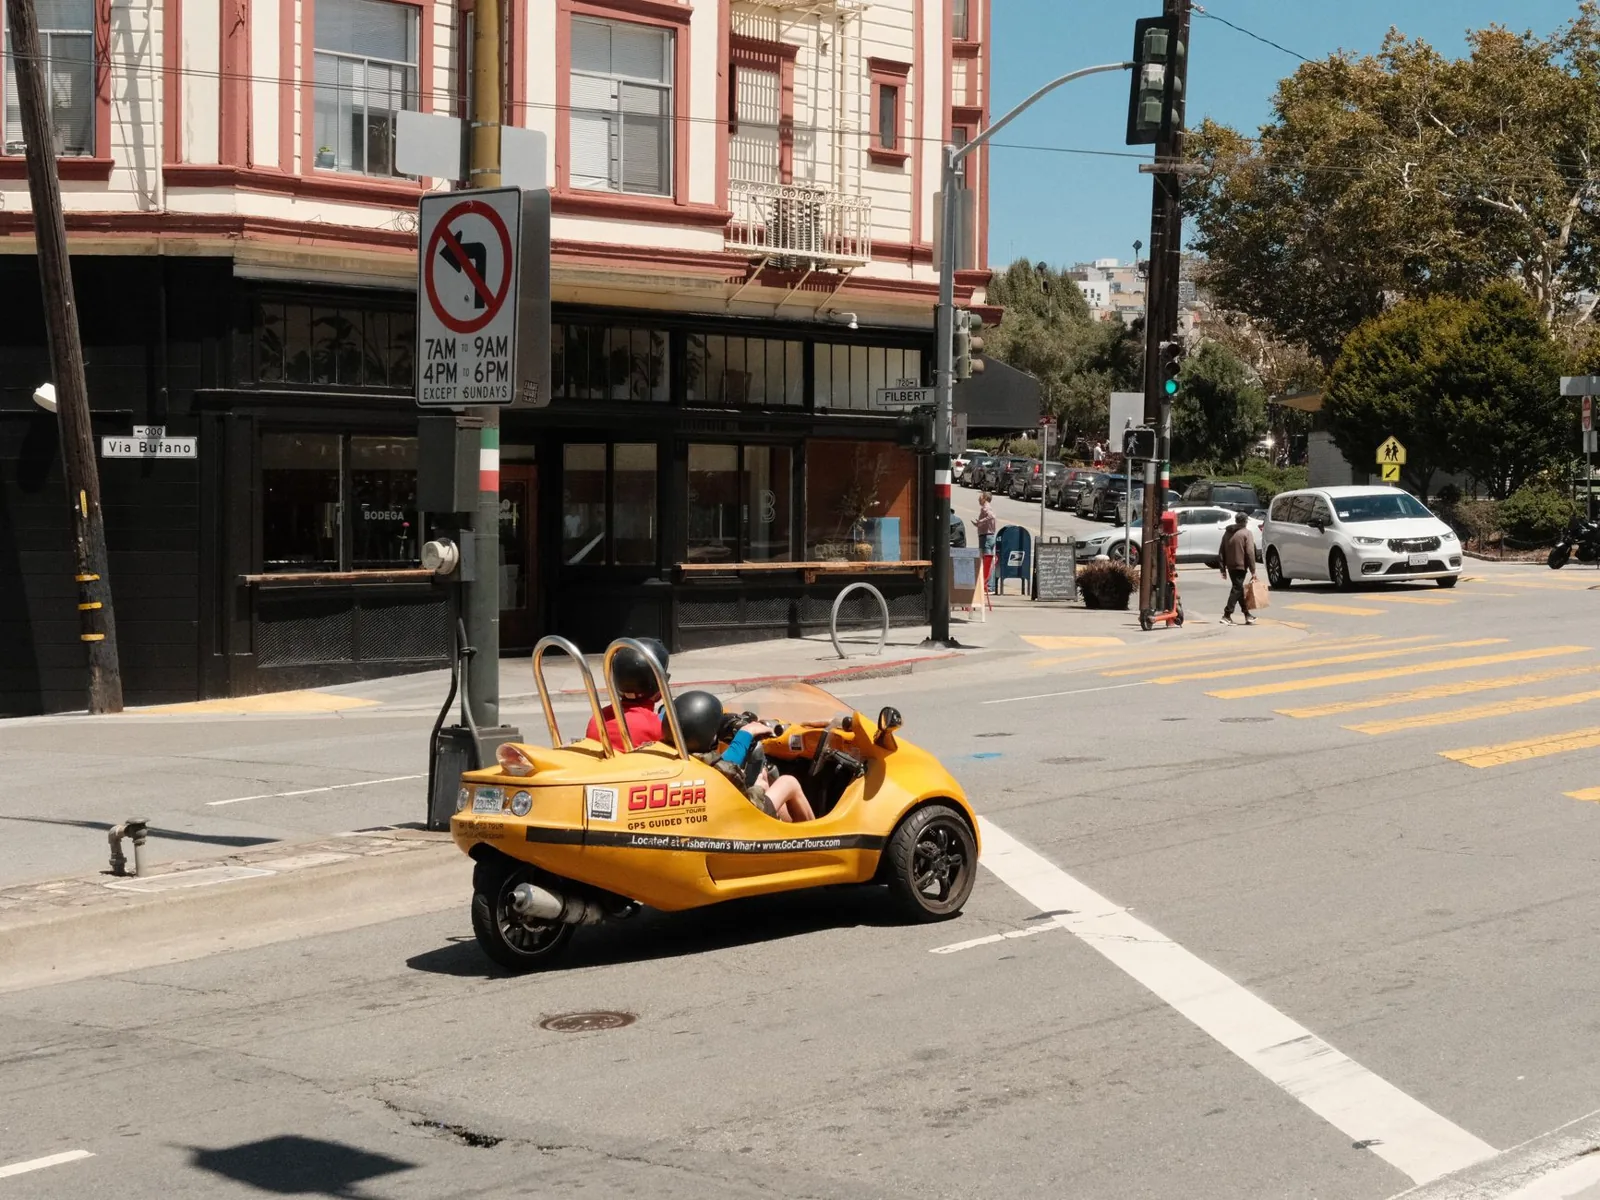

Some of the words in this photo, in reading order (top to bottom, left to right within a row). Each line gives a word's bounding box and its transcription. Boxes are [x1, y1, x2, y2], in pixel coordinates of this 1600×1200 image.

[424, 337, 456, 360] 7AM
[461, 343, 469, 352] TO
[474, 336, 508, 358] 9AM
[423, 362, 458, 384] 4PM
[462, 367, 470, 377] TO
[474, 361, 508, 383] 6PM
[423, 386, 457, 400] EXCEPT
[462, 385, 508, 399] SUNDAYS
[884, 390, 927, 402] FILBERT
[144, 427, 163, 436] 000
[108, 441, 131, 453] Via
[138, 441, 191, 453] Bufano
[363, 510, 405, 521] BODEGA
[627, 821, 646, 831] GPS
[648, 818, 683, 828] GUIDED
[686, 814, 708, 824] TOUR
[631, 834, 669, 846] Located
[733, 841, 756, 851] Wharf
[762, 839, 841, 850] www.GoCarTours.com
